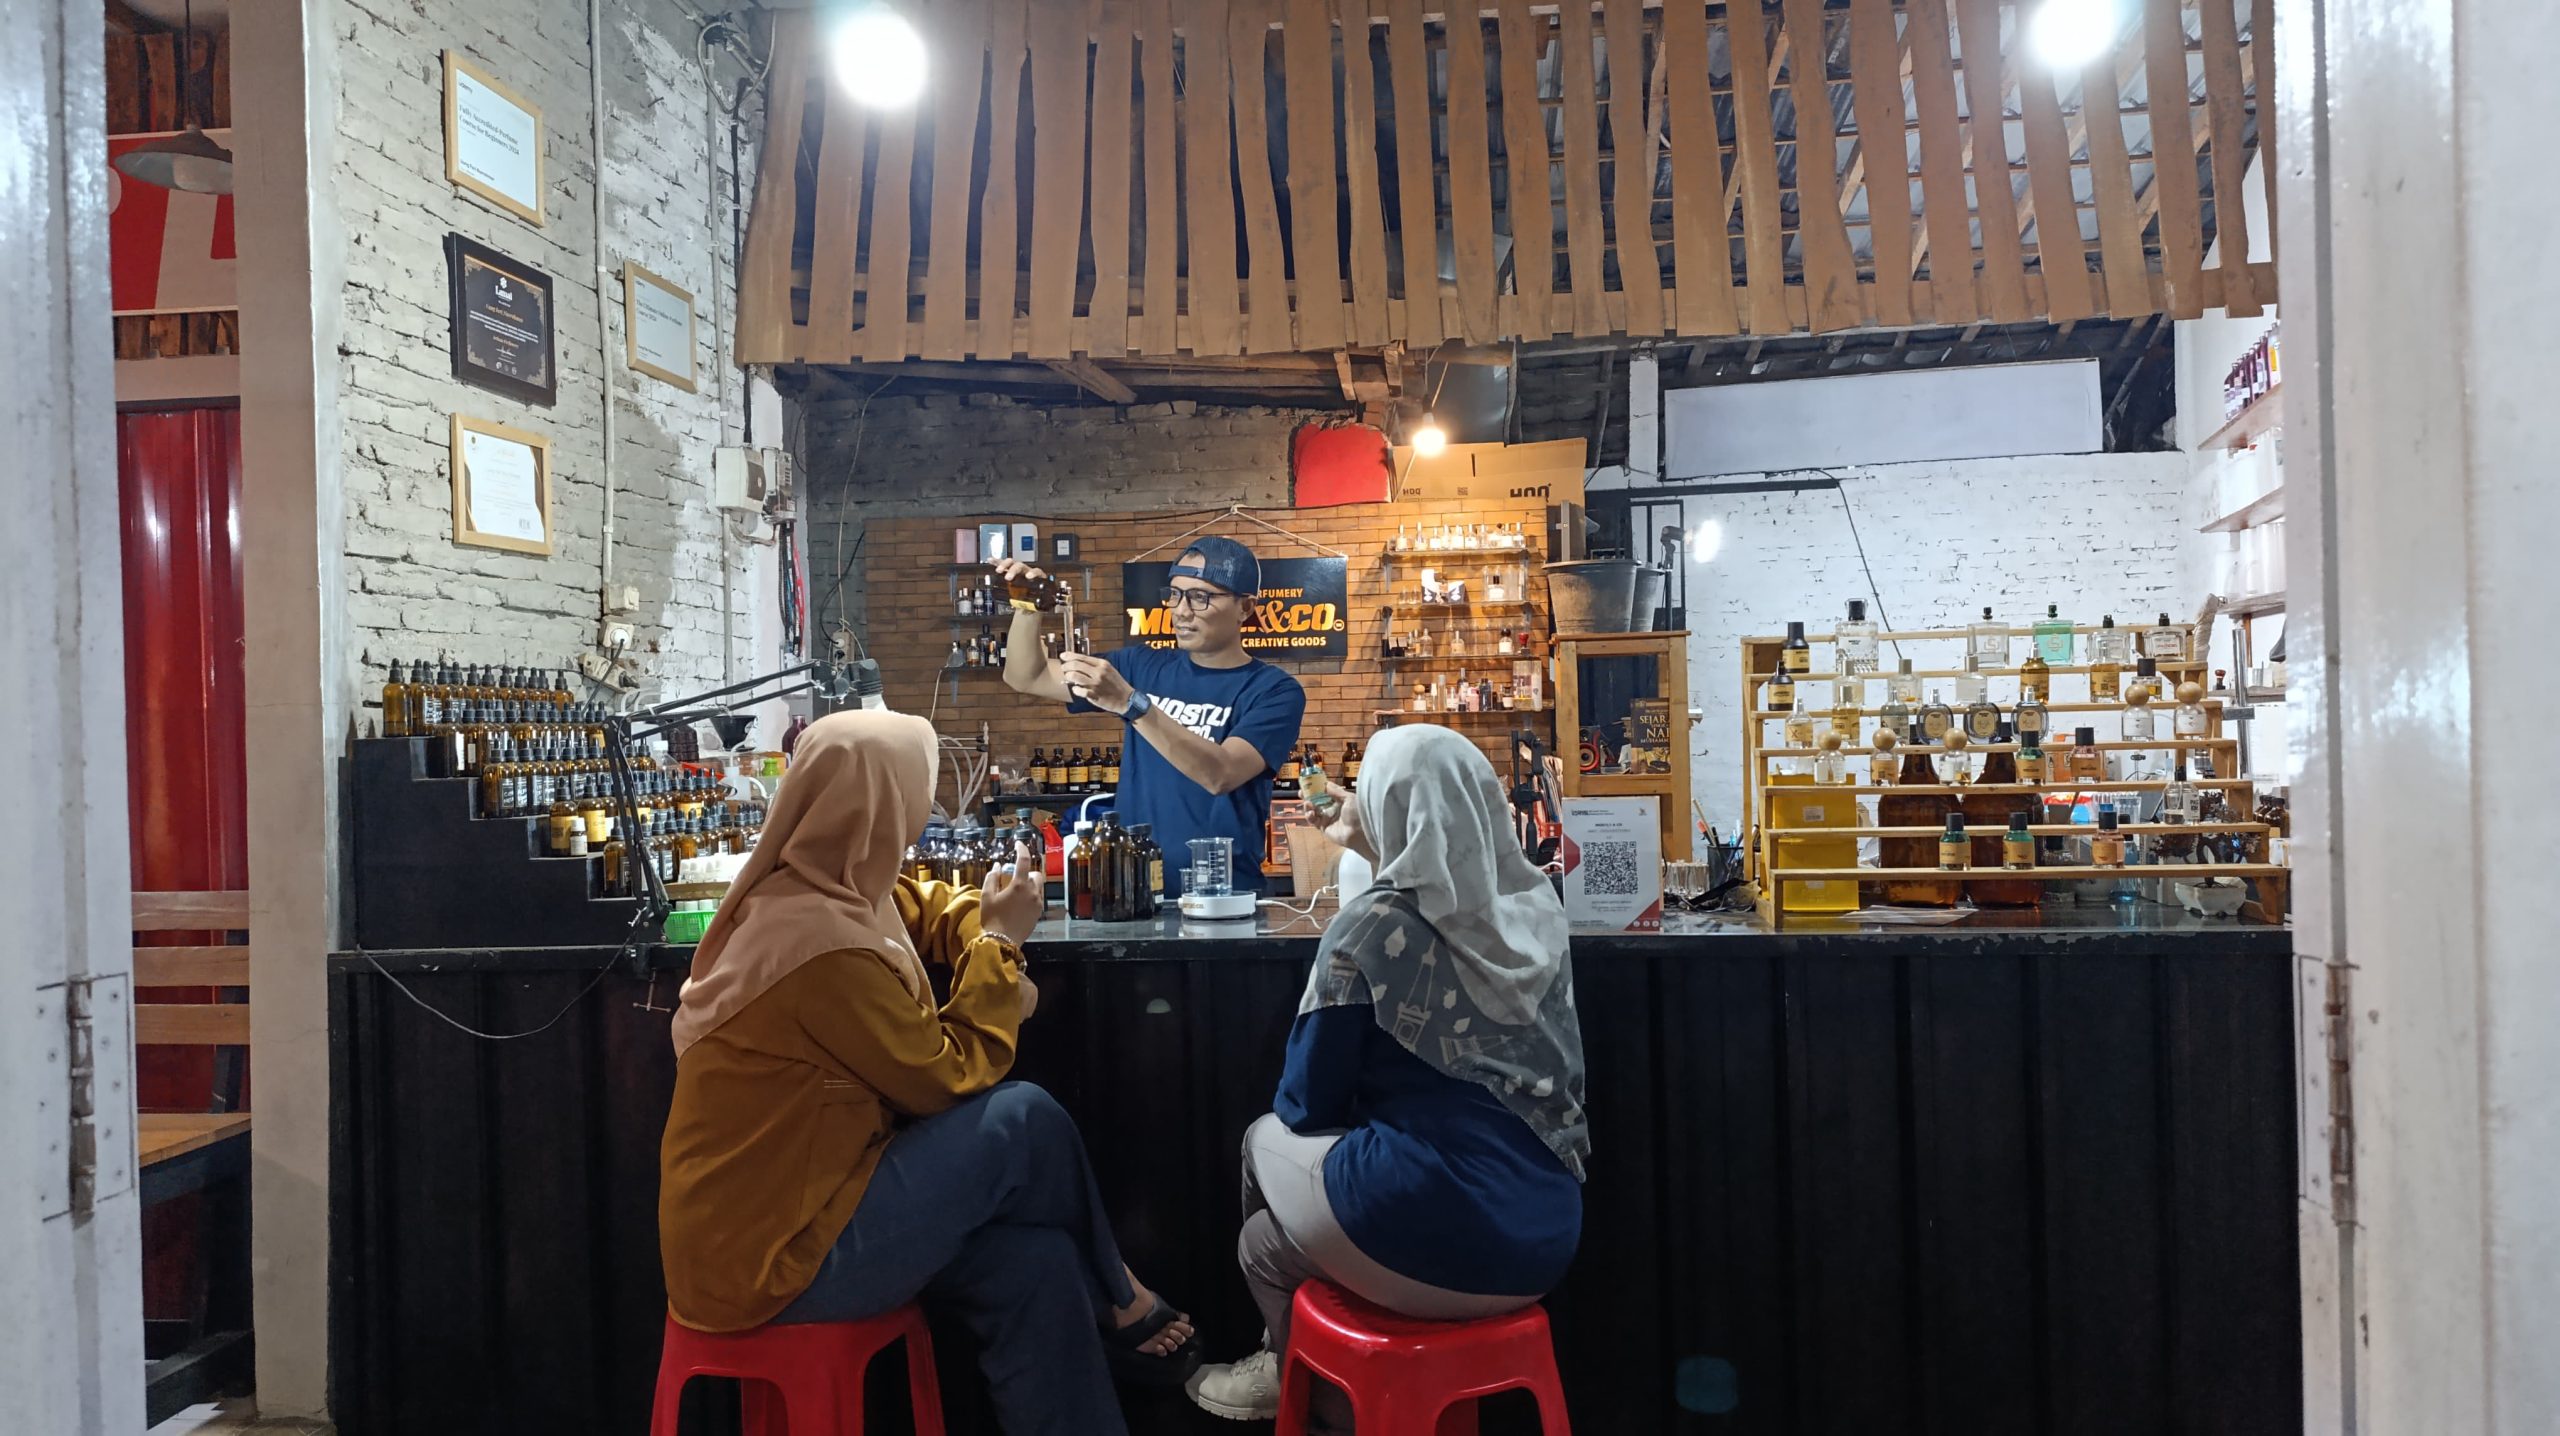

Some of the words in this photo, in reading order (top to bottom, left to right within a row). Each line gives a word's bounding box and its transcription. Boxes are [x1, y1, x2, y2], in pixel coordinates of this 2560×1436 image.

[1258, 588, 1303, 598] RFUMERY
[1242, 637, 1290, 648] CREATIVE
[1291, 636, 1327, 646] GOODS
[1640, 715, 1669, 724] SEJAR
